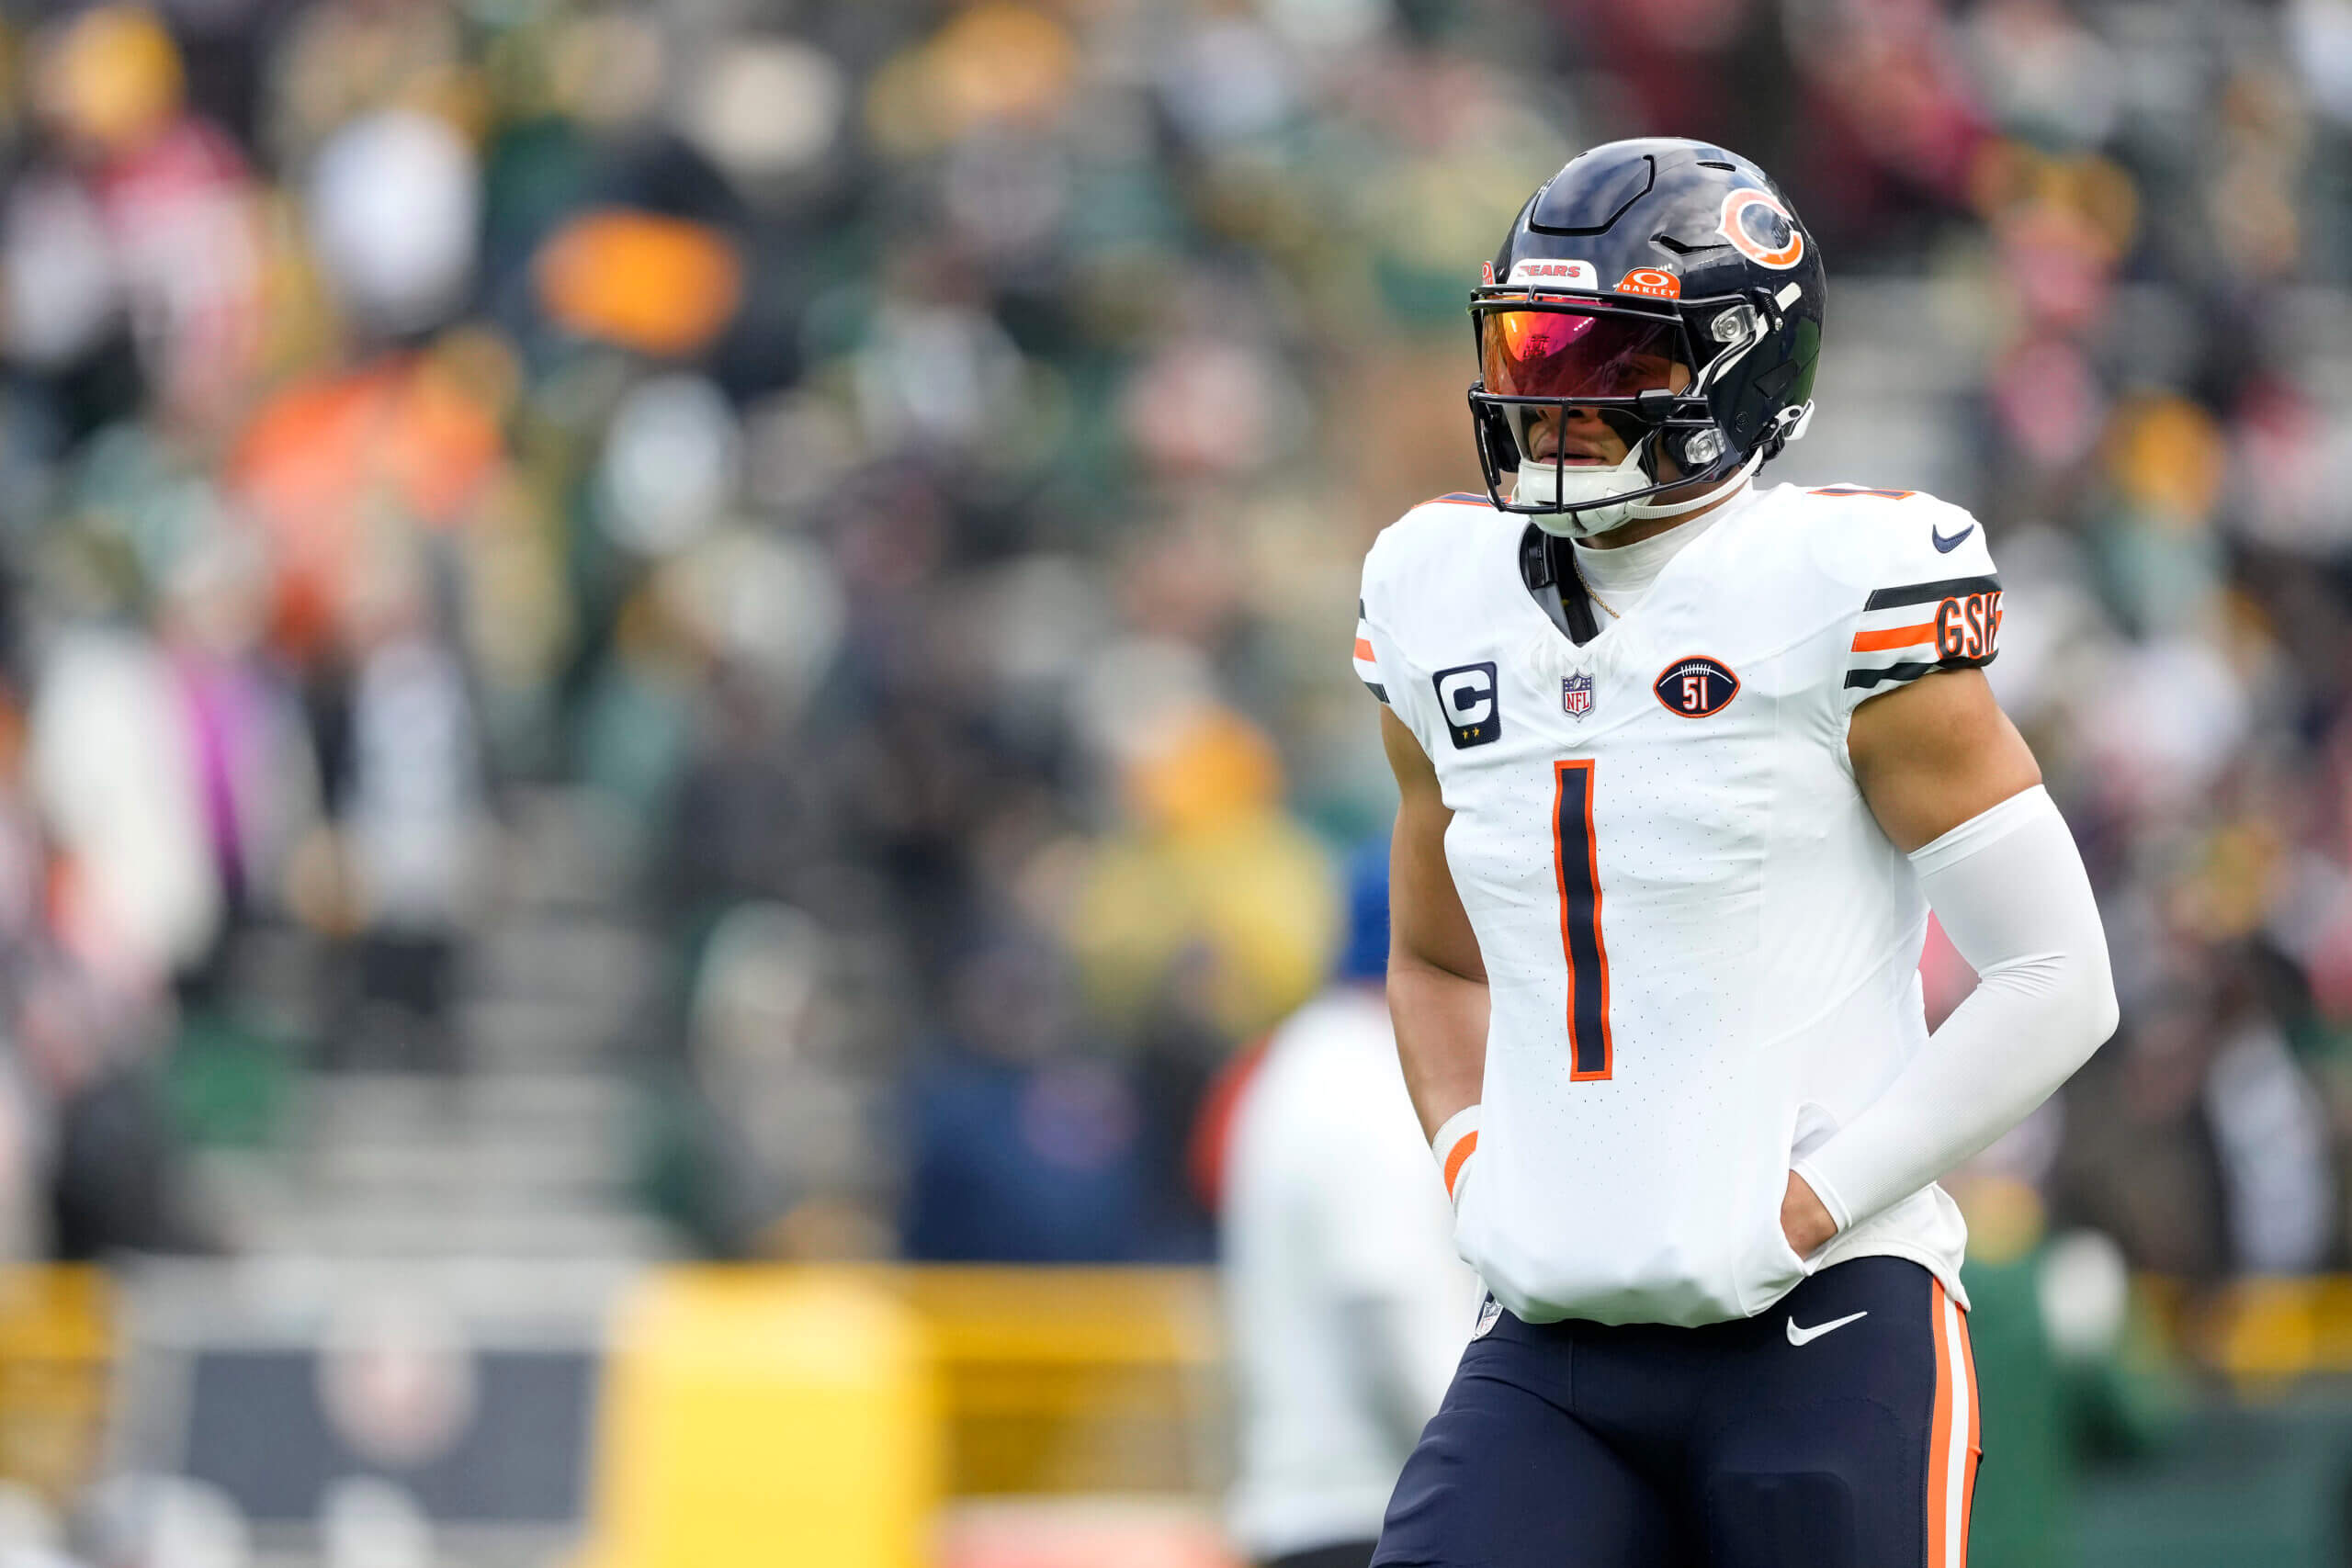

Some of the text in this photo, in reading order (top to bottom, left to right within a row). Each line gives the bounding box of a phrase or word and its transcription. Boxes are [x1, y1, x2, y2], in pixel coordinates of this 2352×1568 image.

[1623, 284, 1676, 297] OAKLEY
[1440, 670, 1492, 728] C
[1566, 692, 1590, 712] NFL
[1682, 676, 1709, 711] 51
[1552, 758, 1613, 1082] 1
